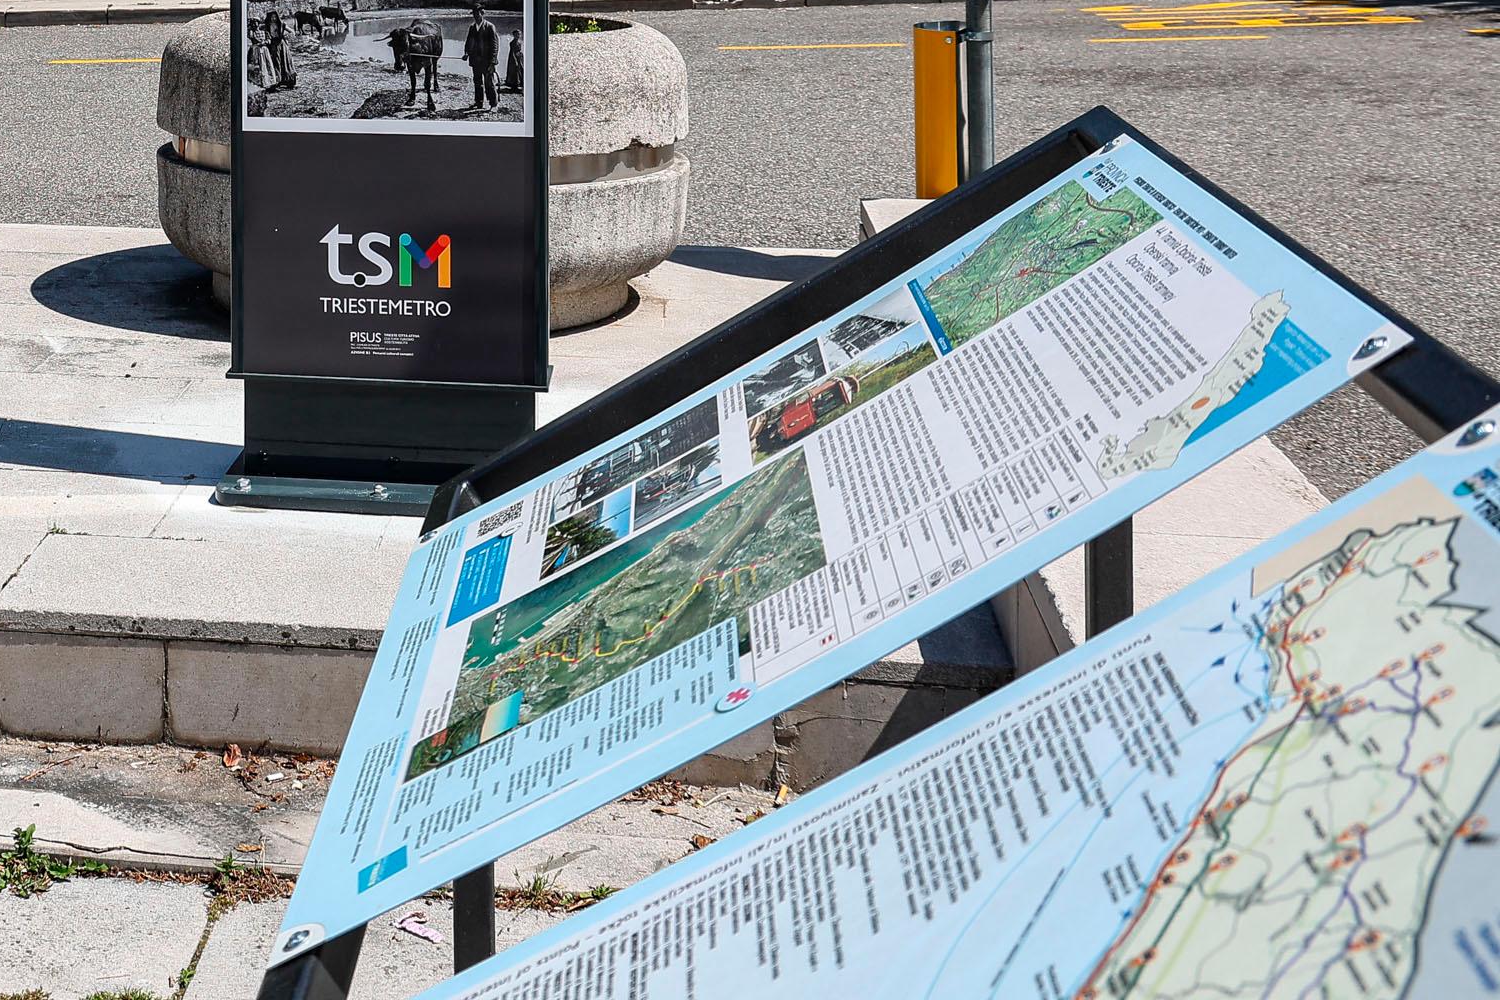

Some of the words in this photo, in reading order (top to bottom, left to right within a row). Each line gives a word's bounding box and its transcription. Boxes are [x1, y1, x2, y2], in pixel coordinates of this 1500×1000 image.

[1105, 161, 1129, 184] PROVINCIA
[1093, 174, 1117, 193] TRIESTE
[320, 297, 452, 317] TRIESTEMETRO
[350, 331, 381, 343] PISUS
[790, 784, 878, 832] Zanimivosti
